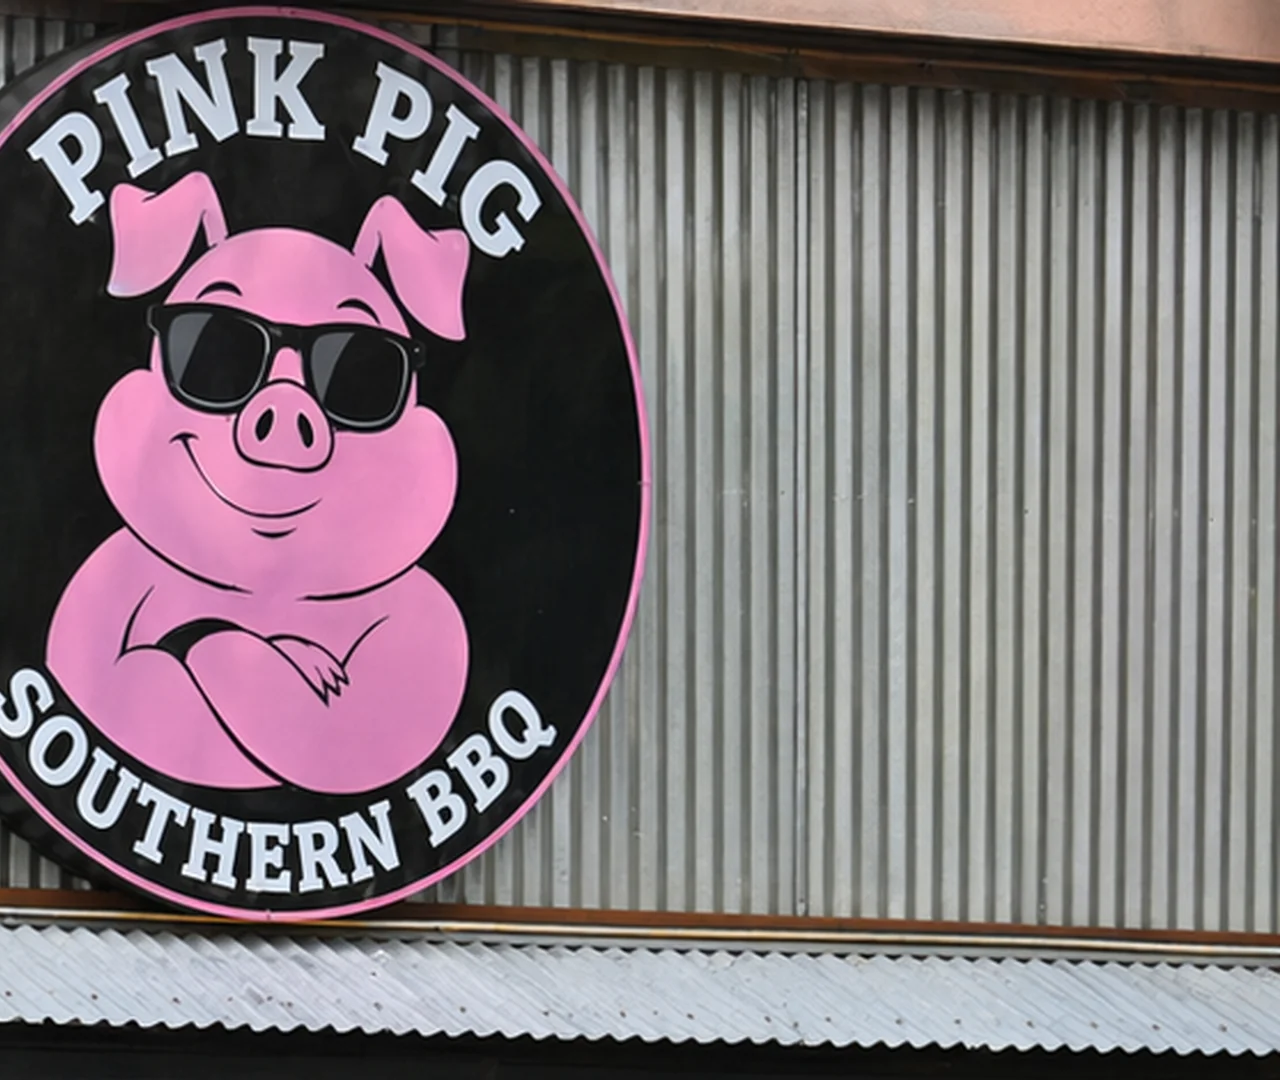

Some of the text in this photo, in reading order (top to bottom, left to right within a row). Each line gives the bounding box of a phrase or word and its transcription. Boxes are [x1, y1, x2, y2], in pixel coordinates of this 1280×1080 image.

[27, 36, 542, 258] PINK PIG
[406, 689, 558, 847] BBQ
